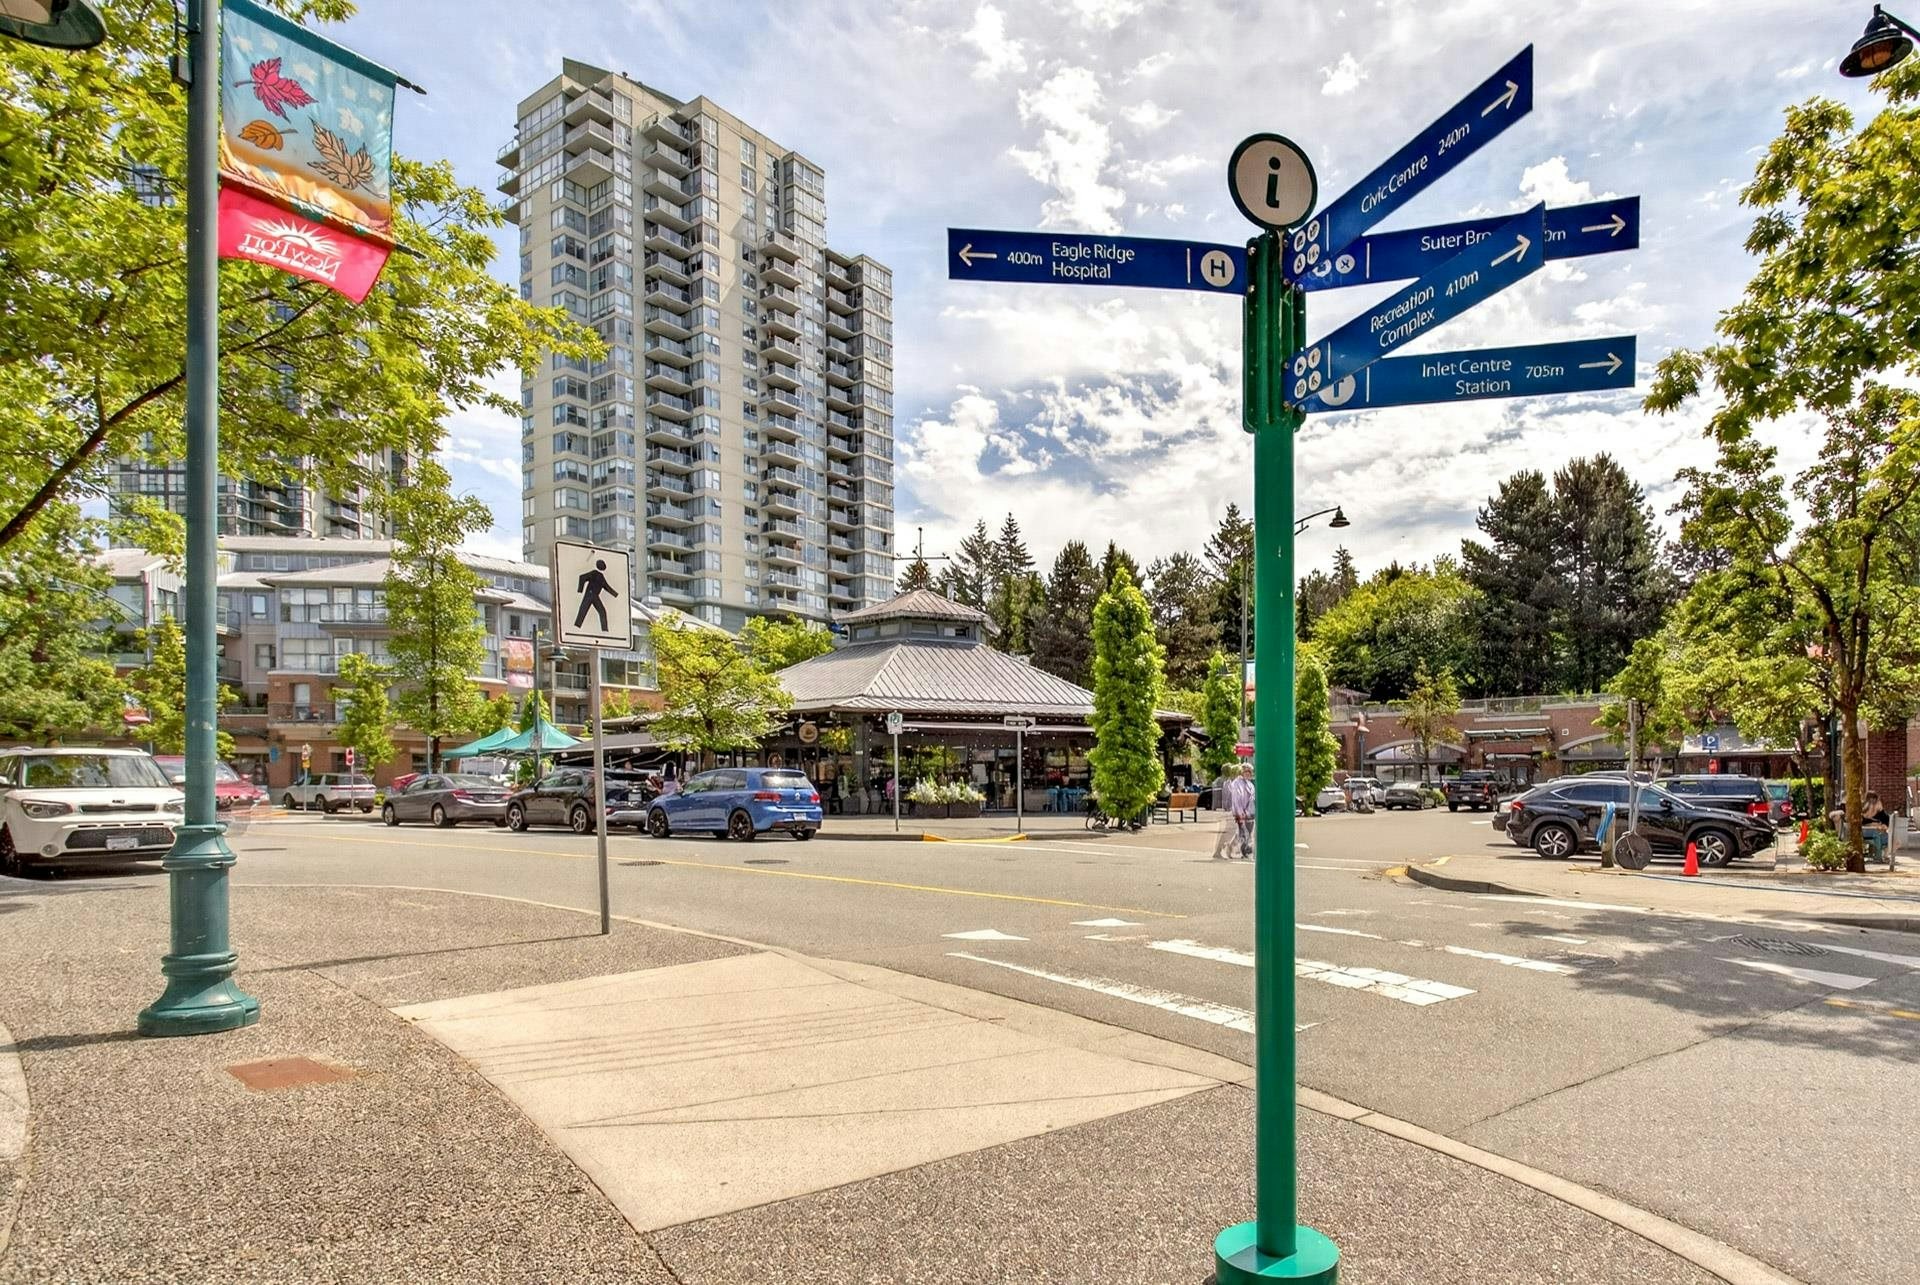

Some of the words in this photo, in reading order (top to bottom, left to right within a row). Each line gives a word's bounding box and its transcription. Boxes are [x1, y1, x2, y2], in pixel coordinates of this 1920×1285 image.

[1361, 185, 1388, 213] Civic
[1388, 155, 1428, 193] Centre
[1438, 123, 1470, 156] 240m
[1421, 235, 1463, 251] Suter
[1007, 251, 1043, 265] 400m
[1052, 242, 1092, 261] Eagle
[1094, 243, 1135, 264] Ridge
[1052, 261, 1111, 279] Hospital
[1210, 259, 1226, 278] H
[1370, 285, 1435, 333] Recreation
[1445, 270, 1479, 297] 410m
[1379, 307, 1435, 348] Complex
[1422, 361, 1456, 378] Inlet
[1459, 359, 1512, 374] Centre
[1525, 365, 1564, 379] 705m
[1456, 379, 1511, 396] Station
